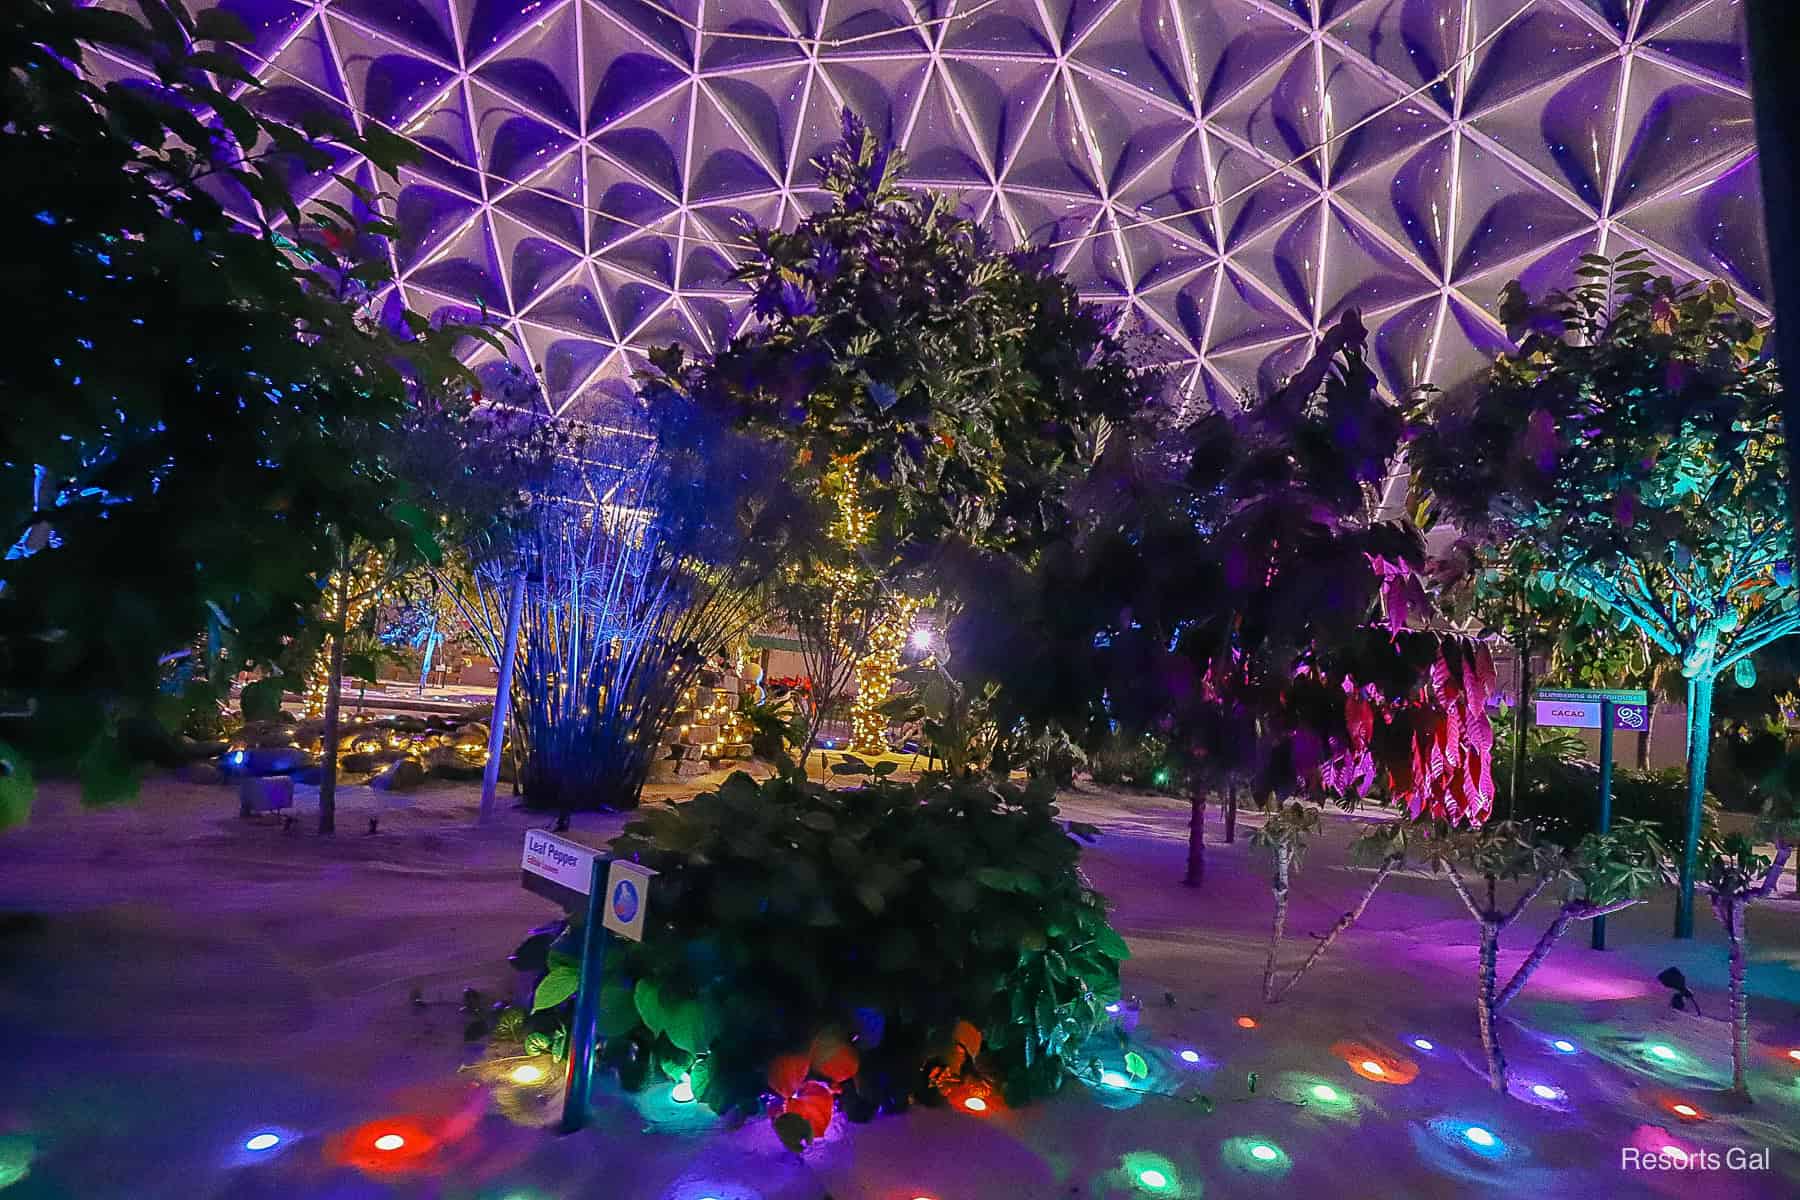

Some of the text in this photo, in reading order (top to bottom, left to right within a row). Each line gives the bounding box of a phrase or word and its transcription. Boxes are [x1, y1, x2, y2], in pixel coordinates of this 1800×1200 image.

[1551, 710, 1585, 718] CACAO
[529, 836, 546, 855] Leaf
[548, 843, 578, 867] Pepper
